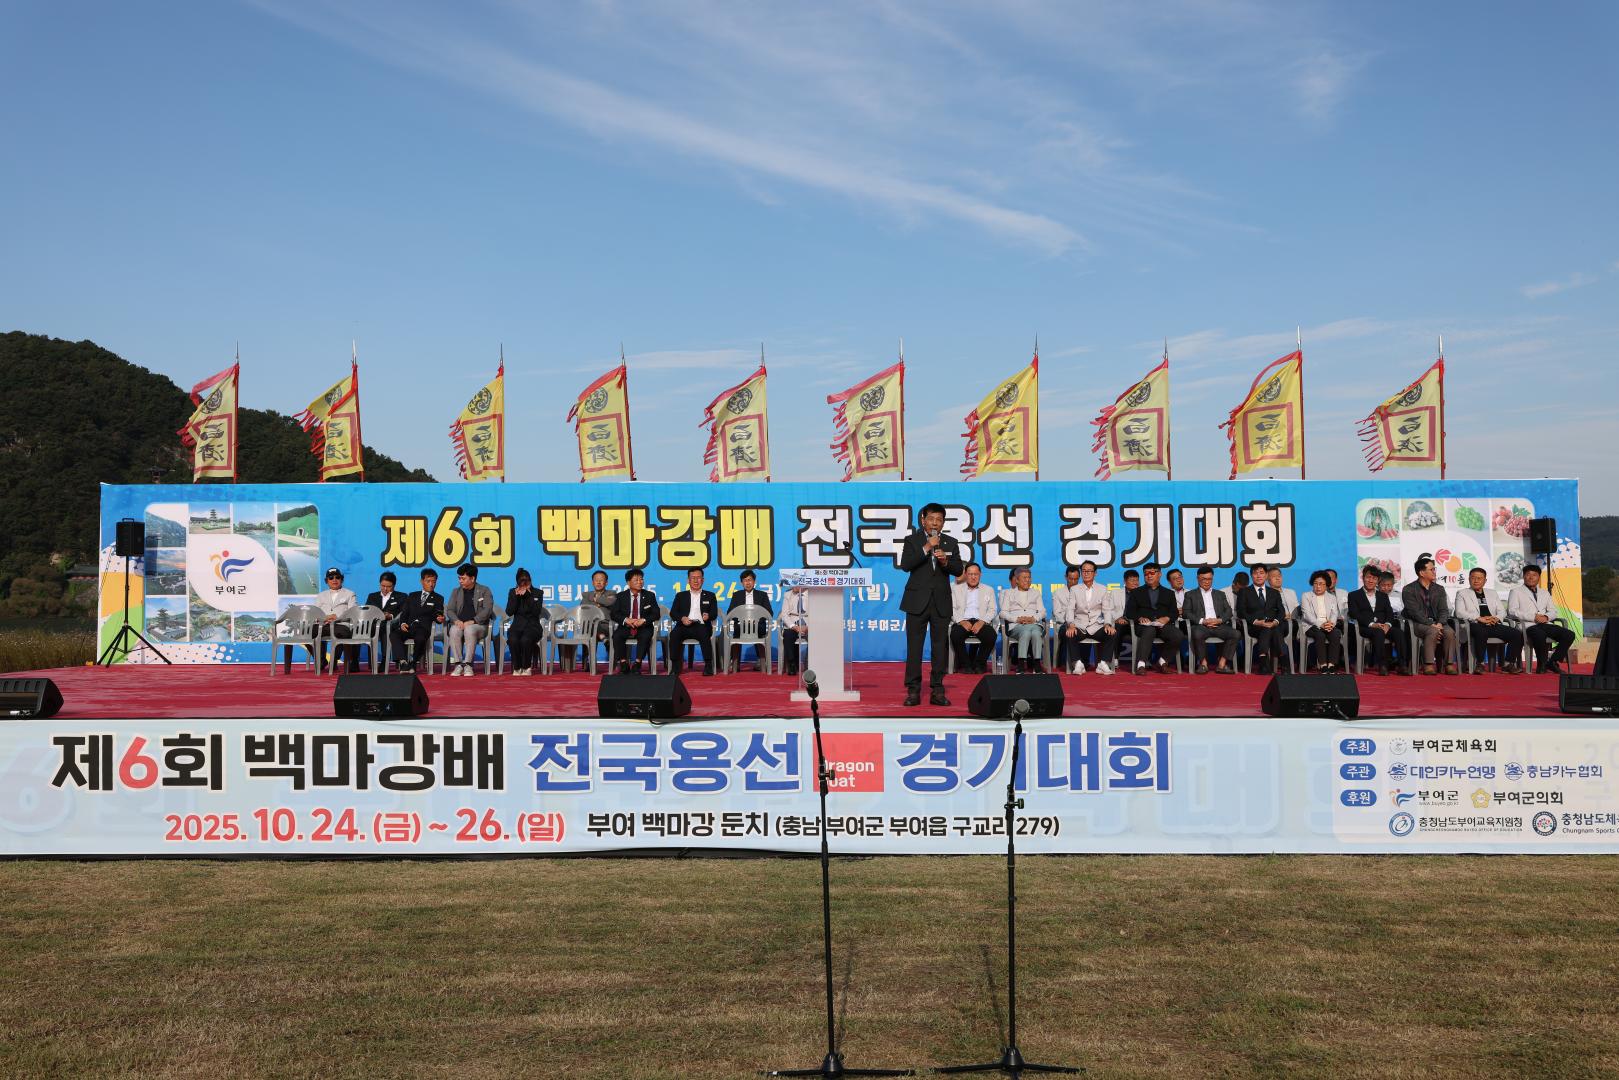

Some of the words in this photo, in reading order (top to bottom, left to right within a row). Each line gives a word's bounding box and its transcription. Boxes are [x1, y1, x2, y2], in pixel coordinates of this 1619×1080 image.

[382, 506, 514, 567] 제6회
[538, 505, 773, 569] 백마강배
[1061, 501, 1296, 568] 경기대회
[837, 577, 866, 585] 경기대회
[215, 585, 247, 595] 부여군
[1346, 740, 1370, 753] 주최
[1412, 739, 1496, 752] 부여군체육회
[51, 733, 222, 790] 제6회
[245, 733, 503, 790] 백마강배
[527, 732, 800, 791] 전국용선
[897, 731, 1169, 791] 경기대회
[824, 760, 875, 772] ragon
[1346, 766, 1370, 778] 주관
[1410, 765, 1496, 779] 대한카누연맹
[1526, 765, 1603, 778] 충남카누협회
[827, 774, 855, 787] oat
[1347, 791, 1370, 805] 후원
[1418, 790, 1458, 801] 부여군
[1493, 791, 1563, 805] 부여군의회
[165, 814, 247, 841] 2025.
[587, 812, 635, 837] 부여
[642, 812, 715, 837] 백마강
[721, 812, 768, 837] 둔치
[775, 816, 821, 837] (충남
[826, 816, 884, 837] 부여군
[889, 816, 947, 837] 부여읍
[952, 816, 1009, 837] 구교리
[1015, 815, 1060, 837] 279)
[1419, 816, 1523, 828] 충청남도부여교육지원청
[1561, 813, 1619, 826] 충청남도체
